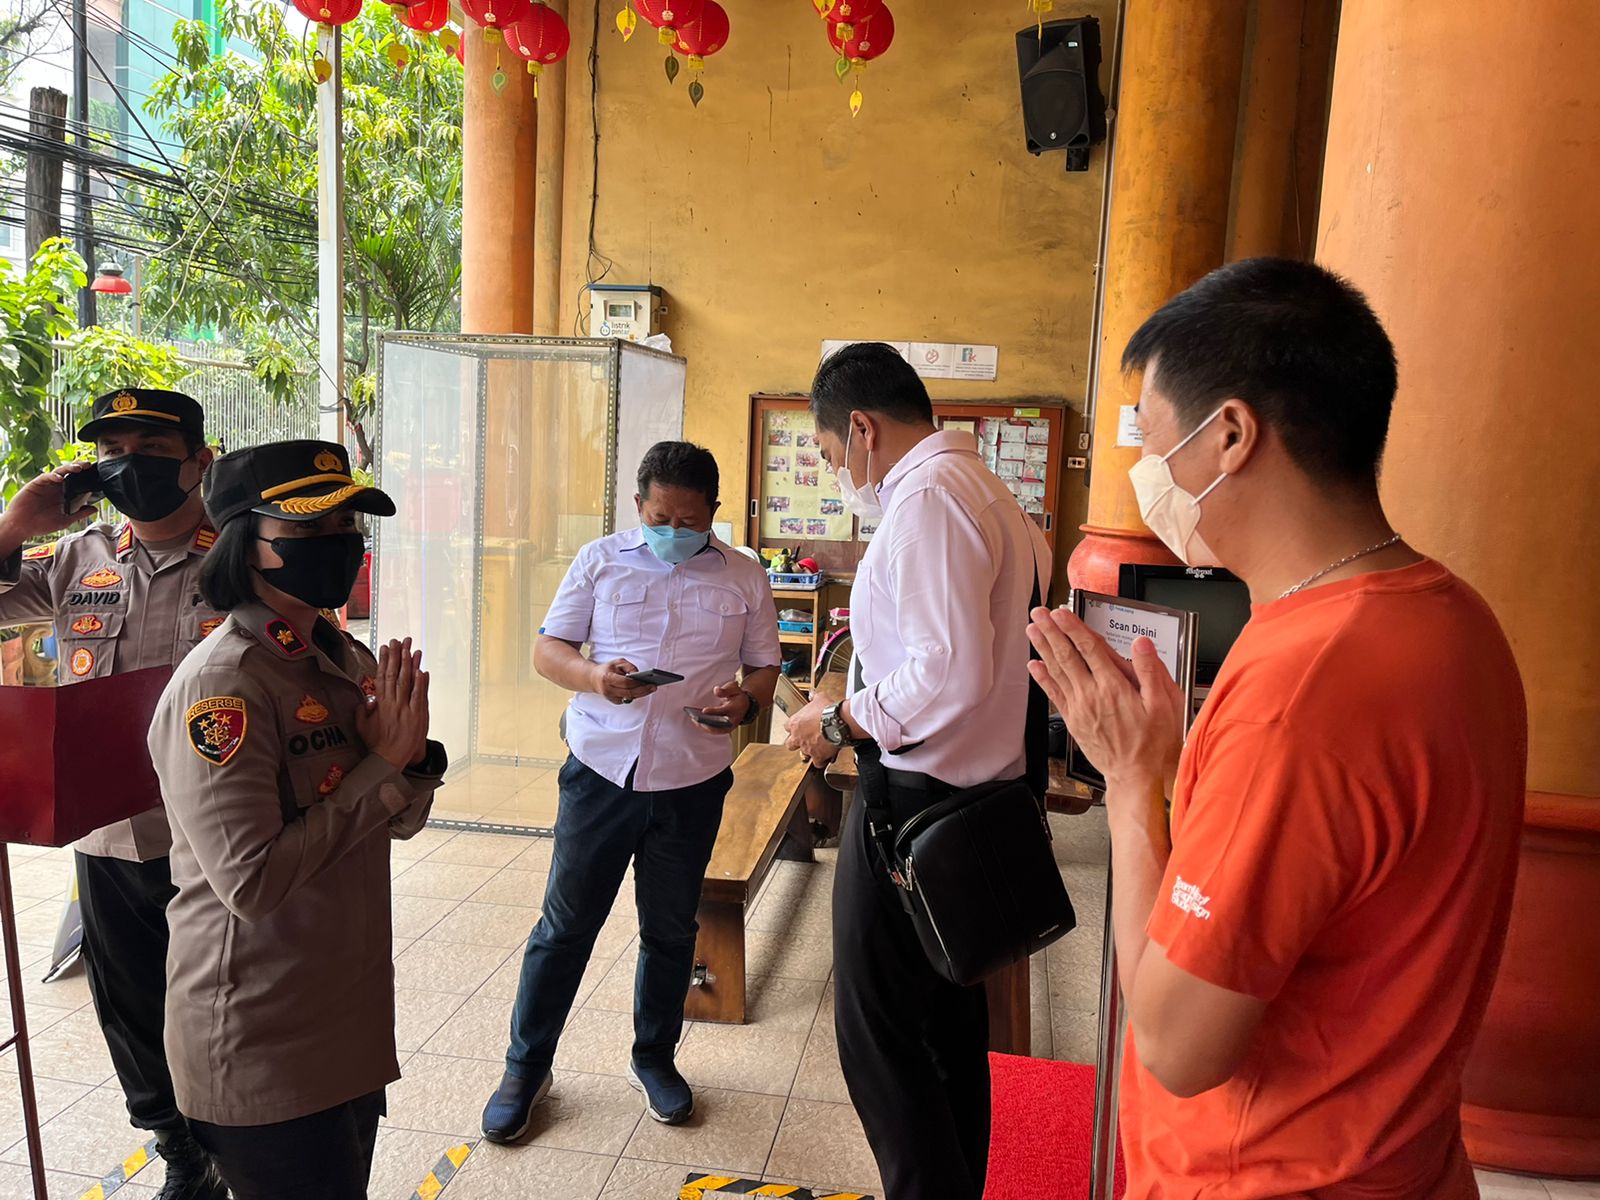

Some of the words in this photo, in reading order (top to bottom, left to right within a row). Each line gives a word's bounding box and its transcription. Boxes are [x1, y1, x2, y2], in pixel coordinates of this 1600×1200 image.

[69, 591, 121, 606] DAVID
[1109, 618, 1130, 632] Scan
[1132, 624, 1157, 638] Disini
[188, 698, 242, 719] RESERSE
[288, 725, 348, 755] OCHA
